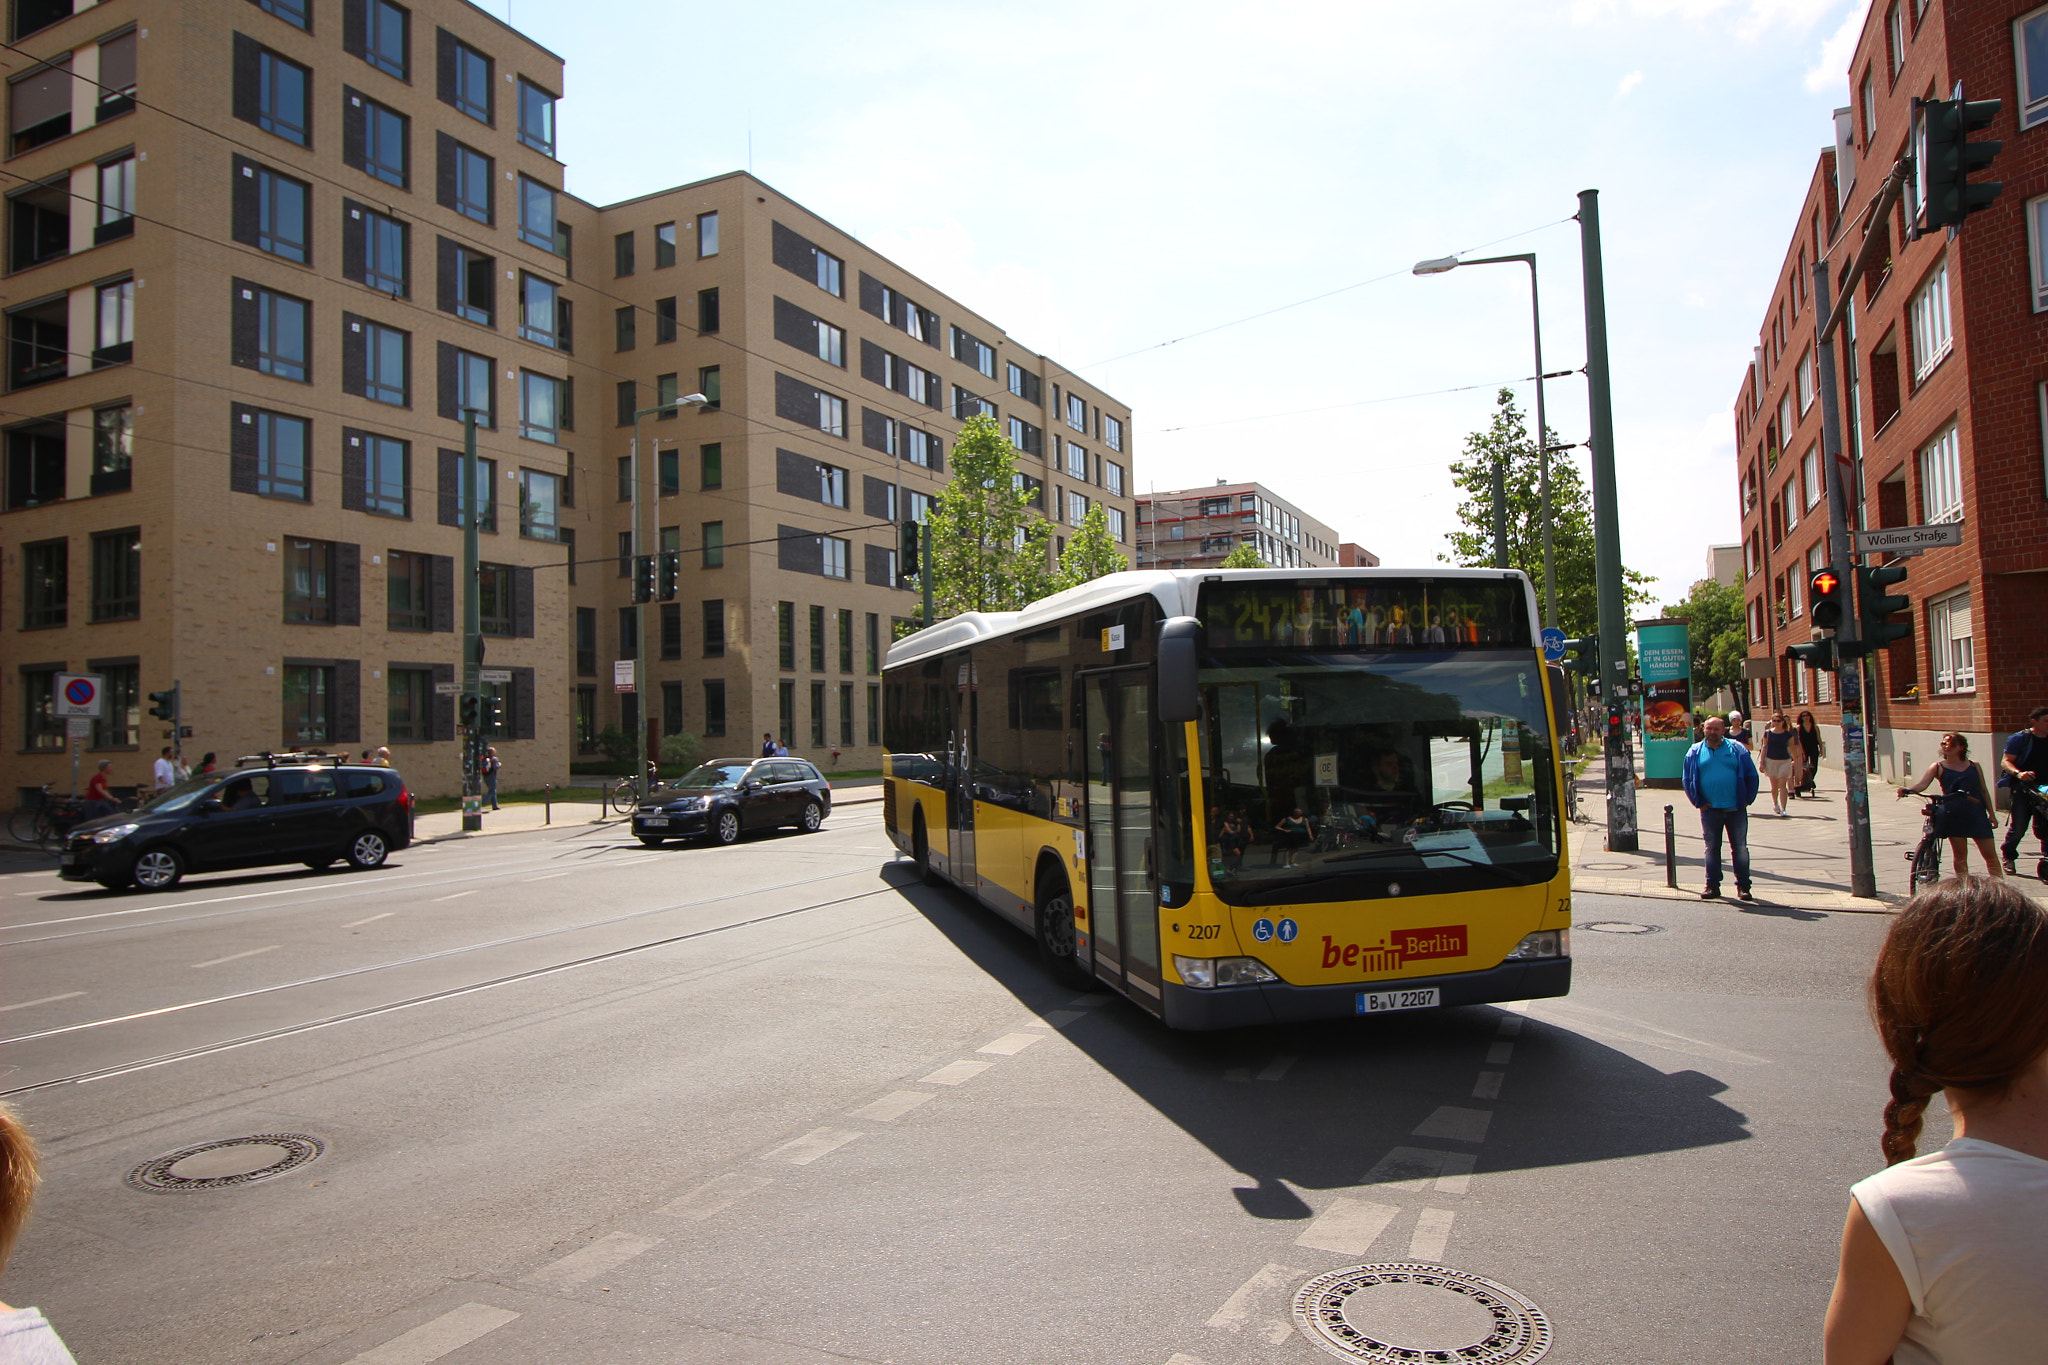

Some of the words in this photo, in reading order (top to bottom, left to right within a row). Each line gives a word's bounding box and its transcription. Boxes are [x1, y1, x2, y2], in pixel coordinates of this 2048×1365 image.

[1867, 534, 1911, 546] Wolliner
[1913, 529, 1948, 542] Straße
[1233, 594, 1290, 641] 247
[67, 706, 90, 714] ZONE
[1188, 924, 1221, 940] 2207
[1321, 935, 1360, 969] be
[1405, 934, 1461, 955] Berlin
